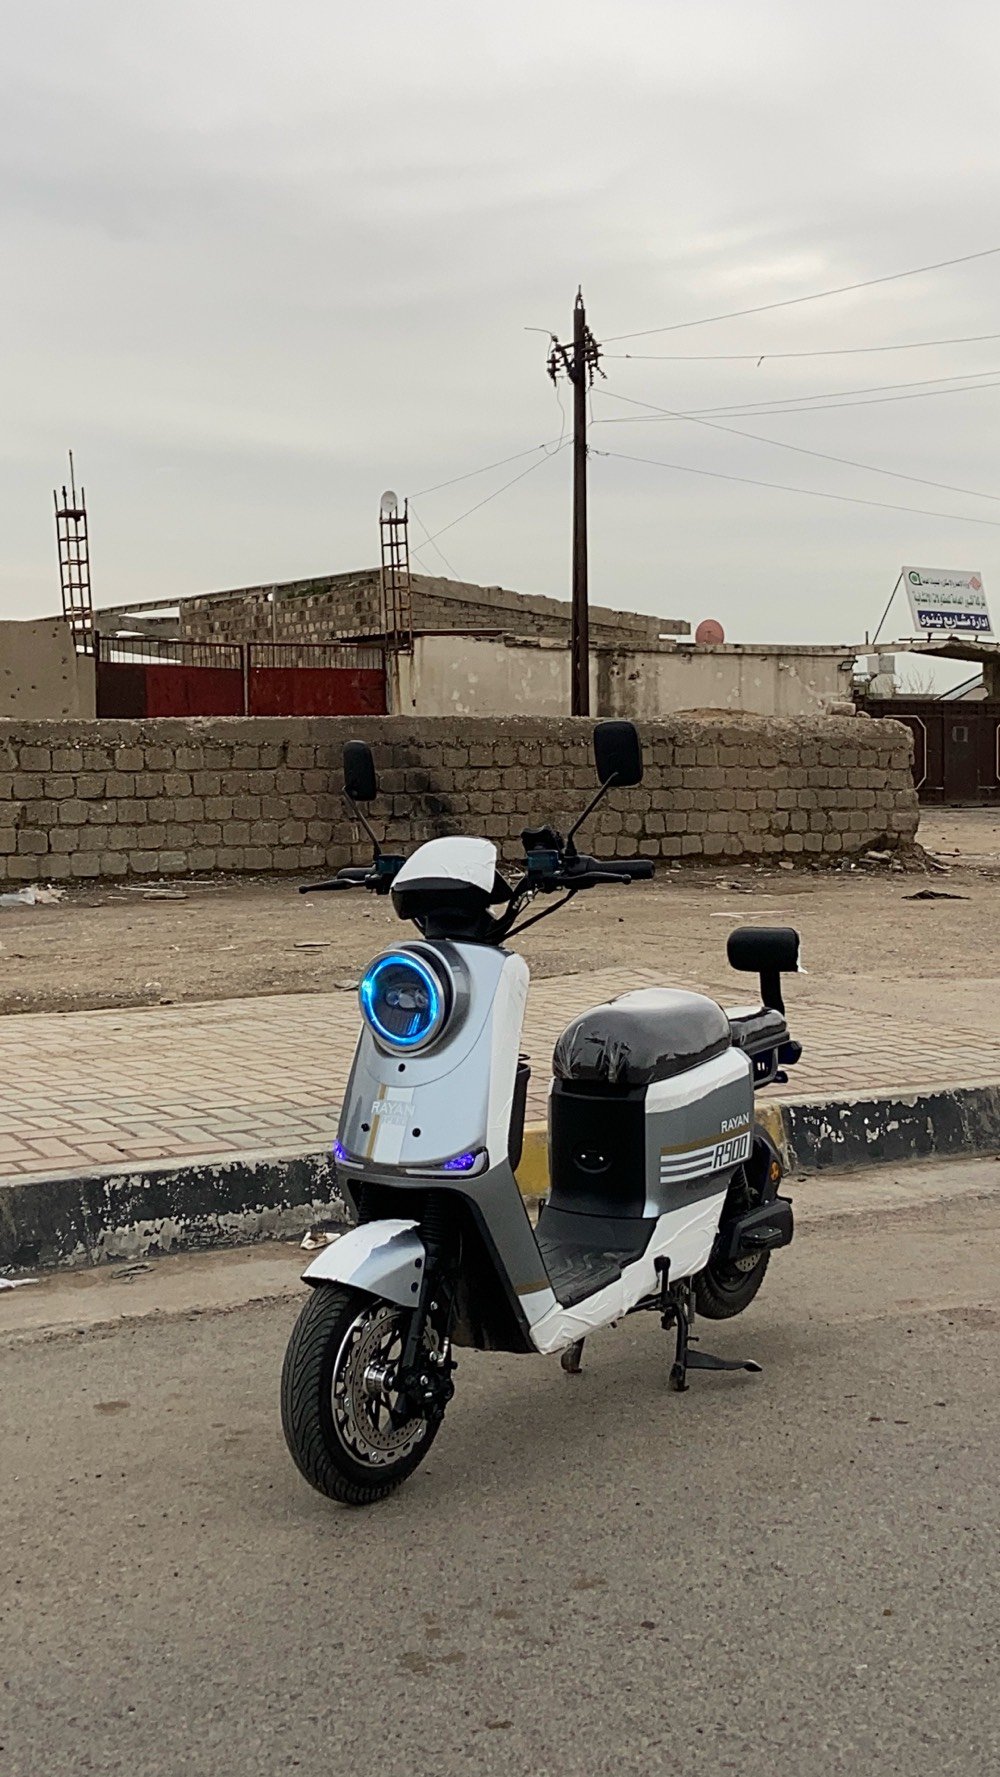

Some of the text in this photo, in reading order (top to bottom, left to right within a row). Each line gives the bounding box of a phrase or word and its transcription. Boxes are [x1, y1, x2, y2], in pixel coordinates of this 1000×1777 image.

[920, 613, 943, 627] نينوى
[944, 613, 971, 629] مشاريع
[371, 1100, 416, 1117] RAYAN
[721, 1112, 750, 1133] RAYAN
[713, 1134, 748, 1169] R900
